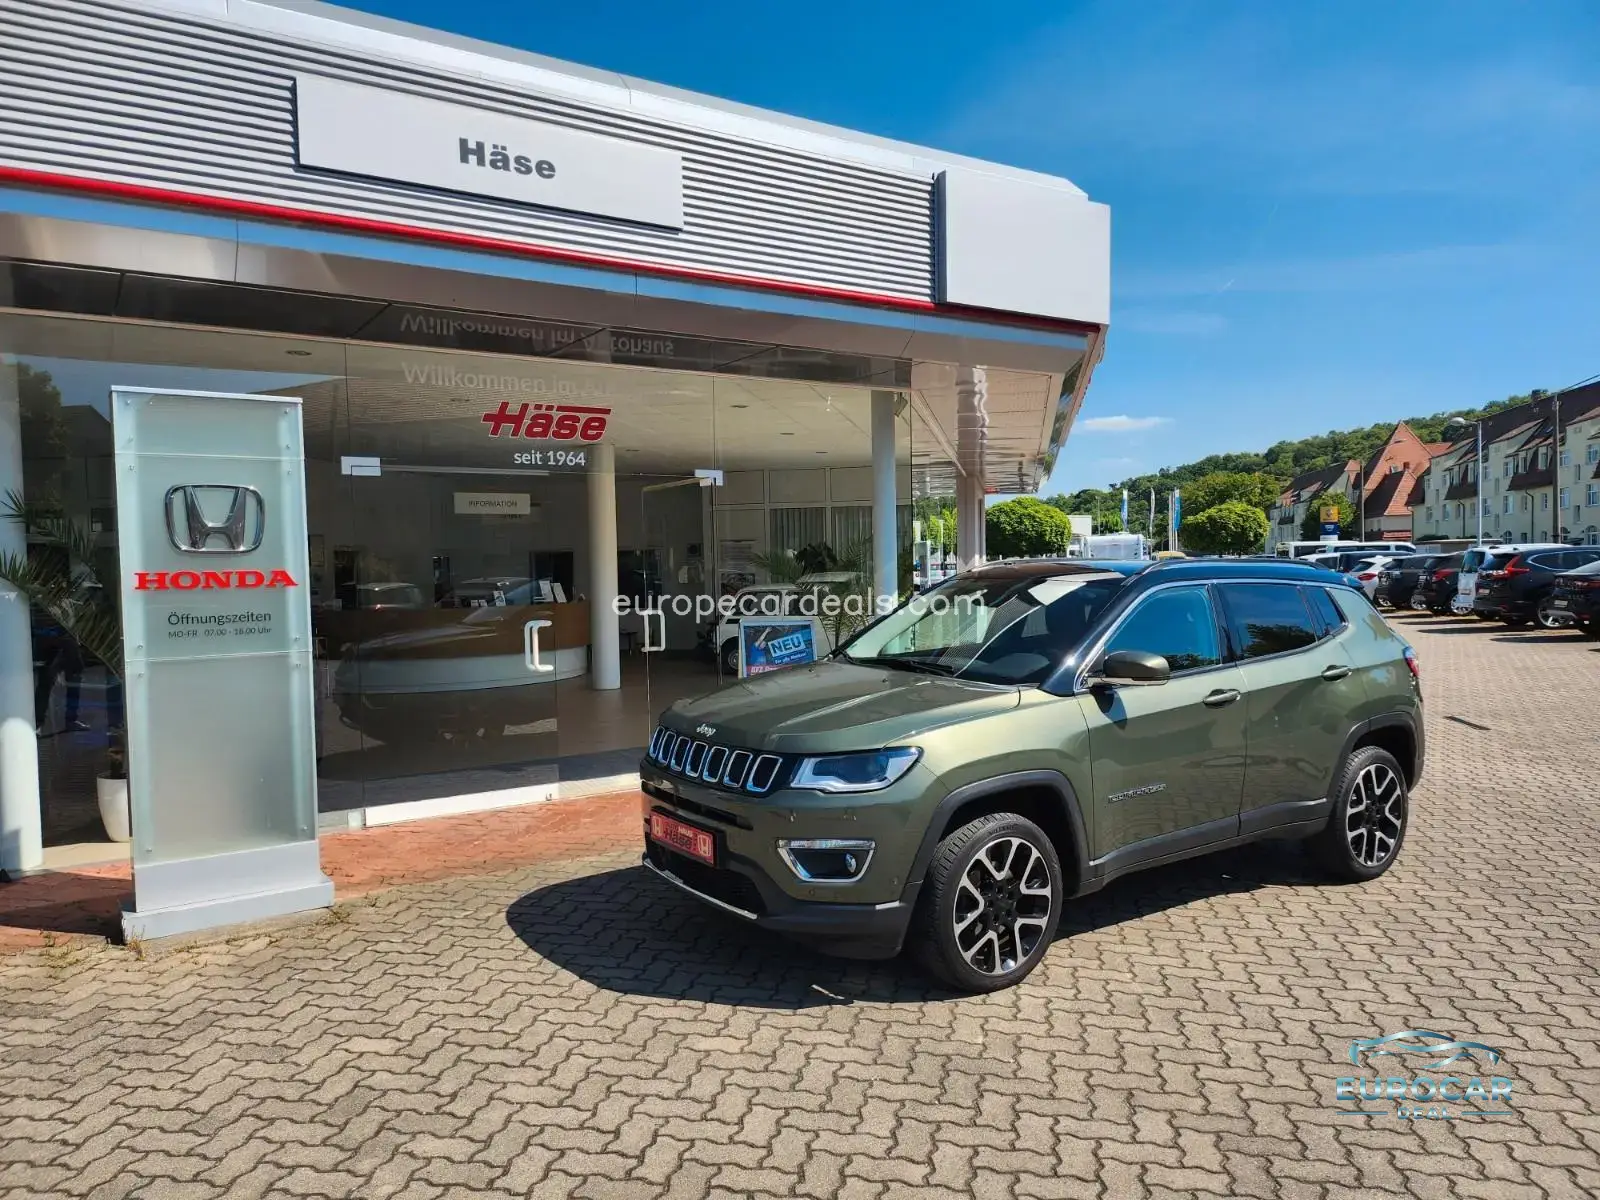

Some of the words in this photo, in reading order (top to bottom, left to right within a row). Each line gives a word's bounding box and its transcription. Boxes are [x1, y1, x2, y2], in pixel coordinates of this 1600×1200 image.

[459, 137, 556, 179] Häse
[402, 361, 547, 393] Willkommen
[481, 401, 612, 441] Häse
[513, 450, 542, 465] seit
[547, 451, 586, 466] 1964
[468, 500, 518, 508] INFORMATION
[134, 570, 298, 590] HONDA
[168, 611, 272, 626] Öffnungszeiten
[168, 629, 198, 639] MO-FR
[257, 626, 272, 634] Uhr
[770, 635, 802, 654] NEU
